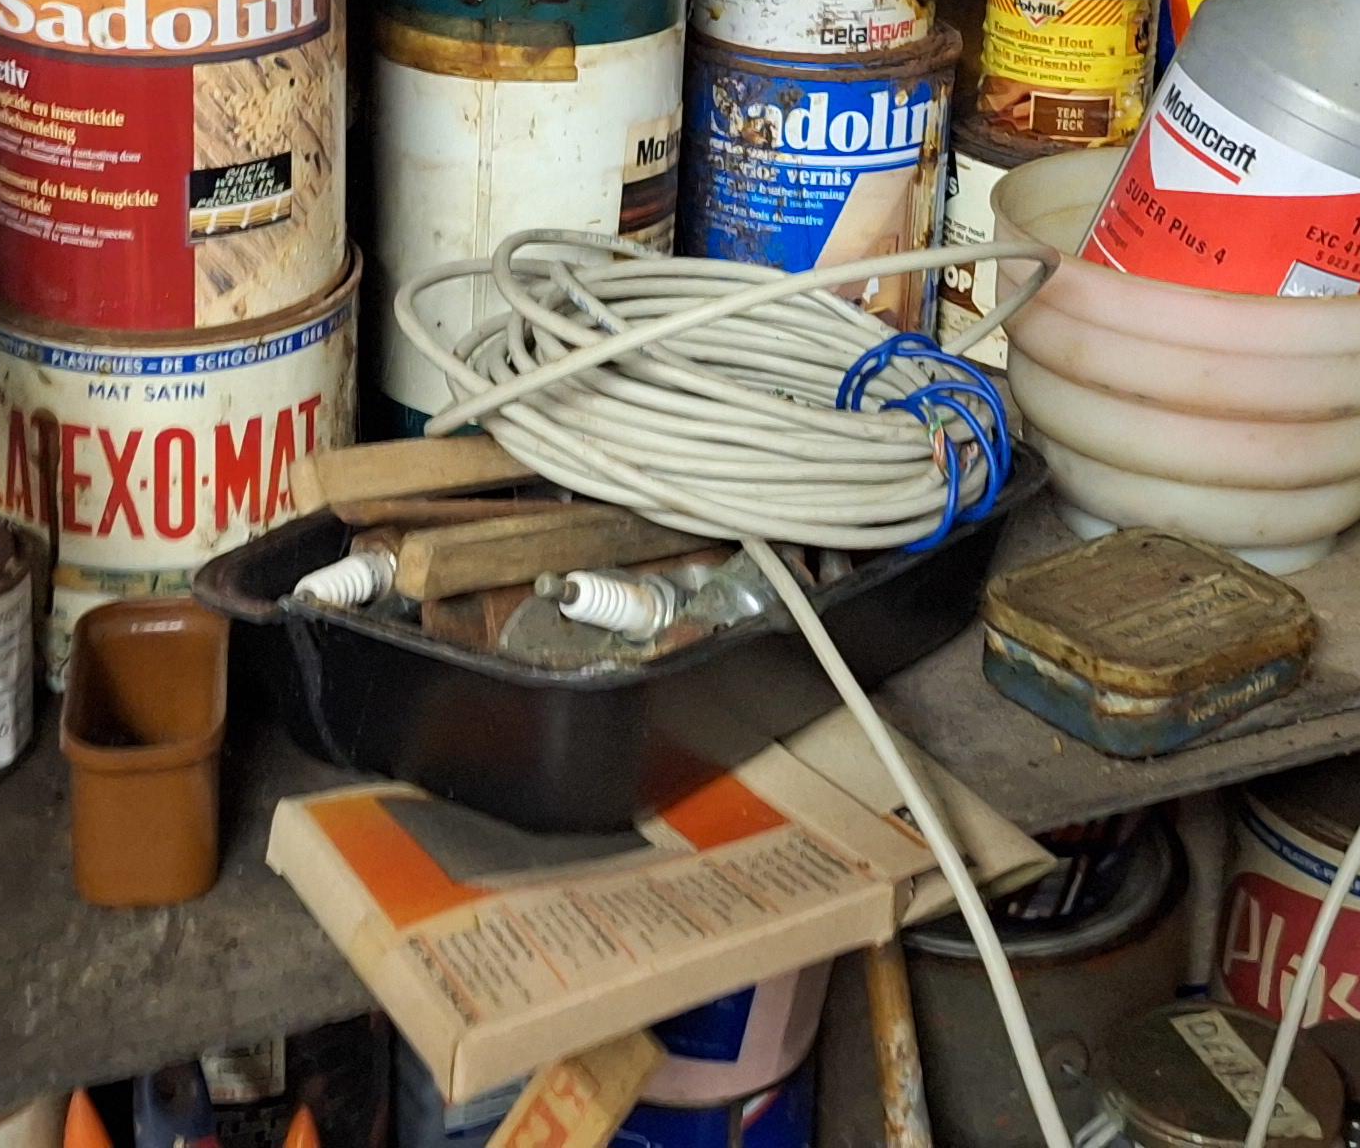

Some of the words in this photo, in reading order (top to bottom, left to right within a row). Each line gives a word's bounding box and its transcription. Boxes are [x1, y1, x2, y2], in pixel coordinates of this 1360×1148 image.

[1058, 35, 1094, 49] Hout
[32, 101, 49, 118] en
[51, 102, 125, 127] insecticide
[1056, 106, 1085, 118] TEAK
[1056, 118, 1084, 132] TECK
[1161, 81, 1258, 178] Motorcraft
[786, 167, 852, 186] vernis
[40, 179, 57, 198] du
[60, 181, 89, 202] bois
[91, 188, 159, 211] fongicide
[1124, 177, 1167, 226] SUPER
[1168, 218, 1209, 256] Plus
[1213, 247, 1227, 266] 4
[1305, 225, 1340, 249] EXC
[51, 350, 142, 375] PLASTIQUES
[161, 356, 183, 375] DE
[195, 338, 292, 371] SCHOONSTE
[87, 382, 131, 402] MAT
[143, 381, 206, 403] SATIN
